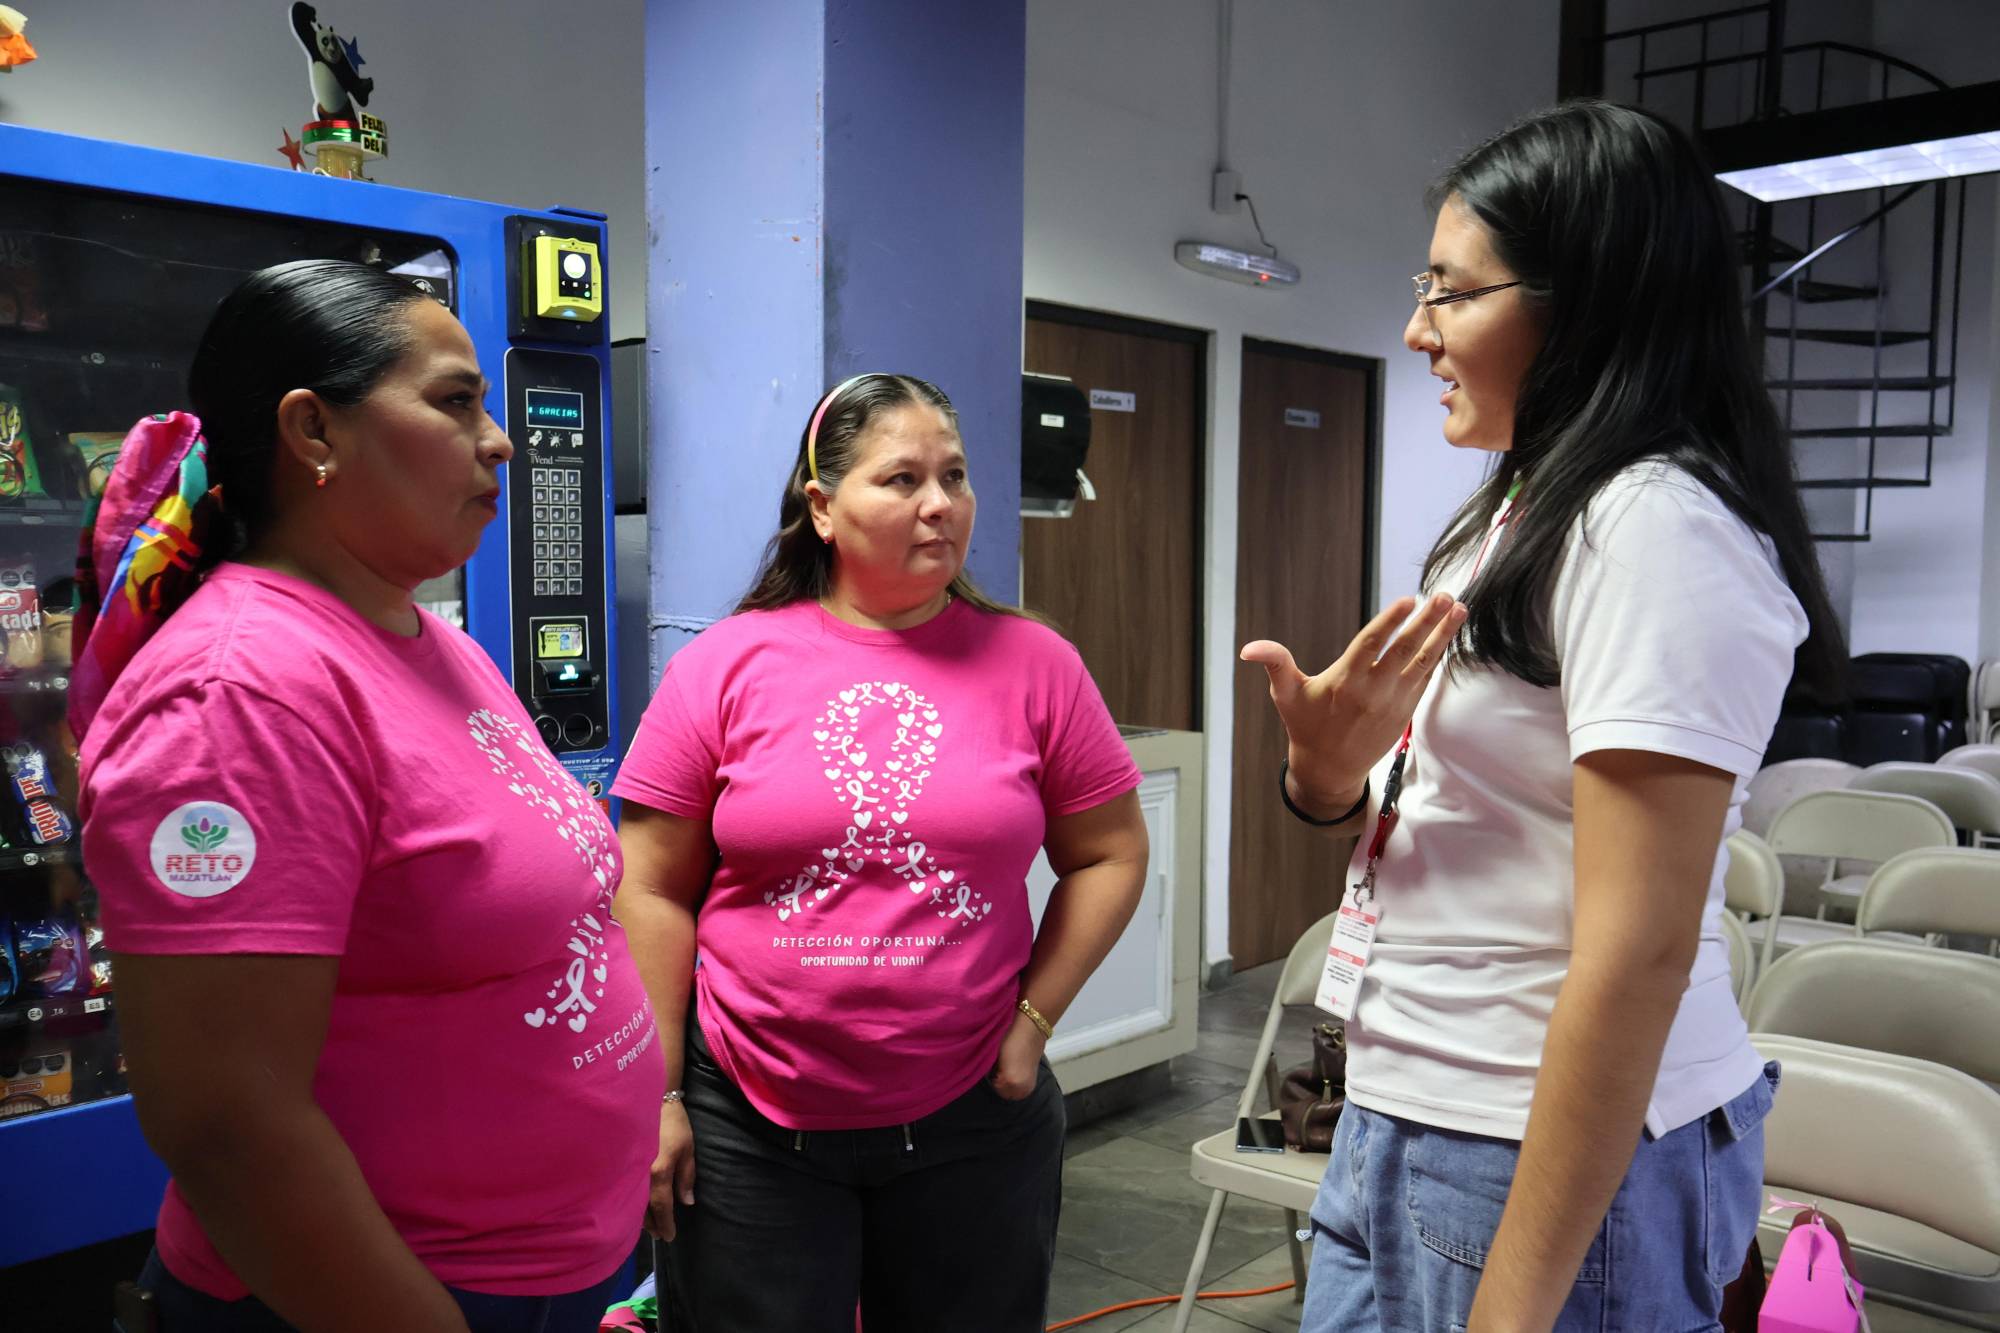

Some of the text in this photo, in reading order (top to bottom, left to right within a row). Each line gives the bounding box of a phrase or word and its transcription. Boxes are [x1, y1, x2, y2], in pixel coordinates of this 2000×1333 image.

[364, 136, 380, 152] DEL
[539, 407, 578, 418] GRACIAS
[165, 854, 243, 873] RETO
[772, 934, 962, 948] DETECCIÓN OPORTUNA...
[800, 956, 868, 967] OPORTUNIDAD
[873, 956, 886, 967] DE
[572, 1009, 644, 1070] DETECCIÓN
